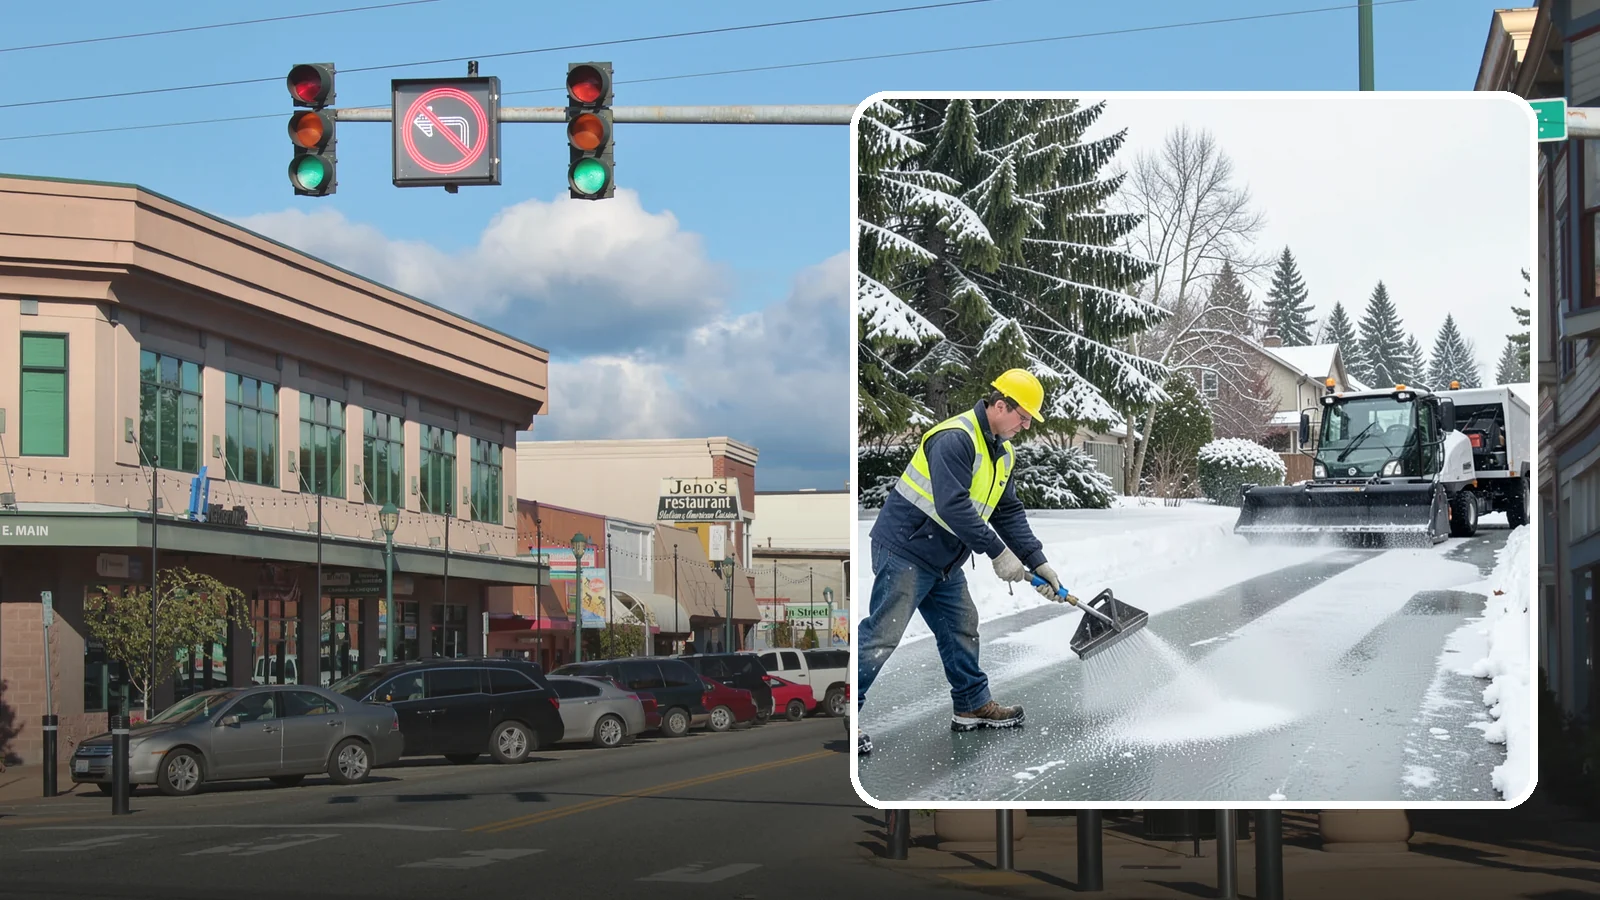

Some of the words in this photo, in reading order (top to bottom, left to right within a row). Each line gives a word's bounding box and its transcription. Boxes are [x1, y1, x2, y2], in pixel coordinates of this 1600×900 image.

[669, 480, 727, 494] Jeno's
[665, 496, 731, 509] restaurant
[658, 510, 682, 520] Italian
[686, 509, 714, 519] American
[715, 509, 738, 519] Cuisine
[2, 525, 13, 536] E.
[15, 525, 49, 536] MAIN
[797, 608, 828, 616] Street
